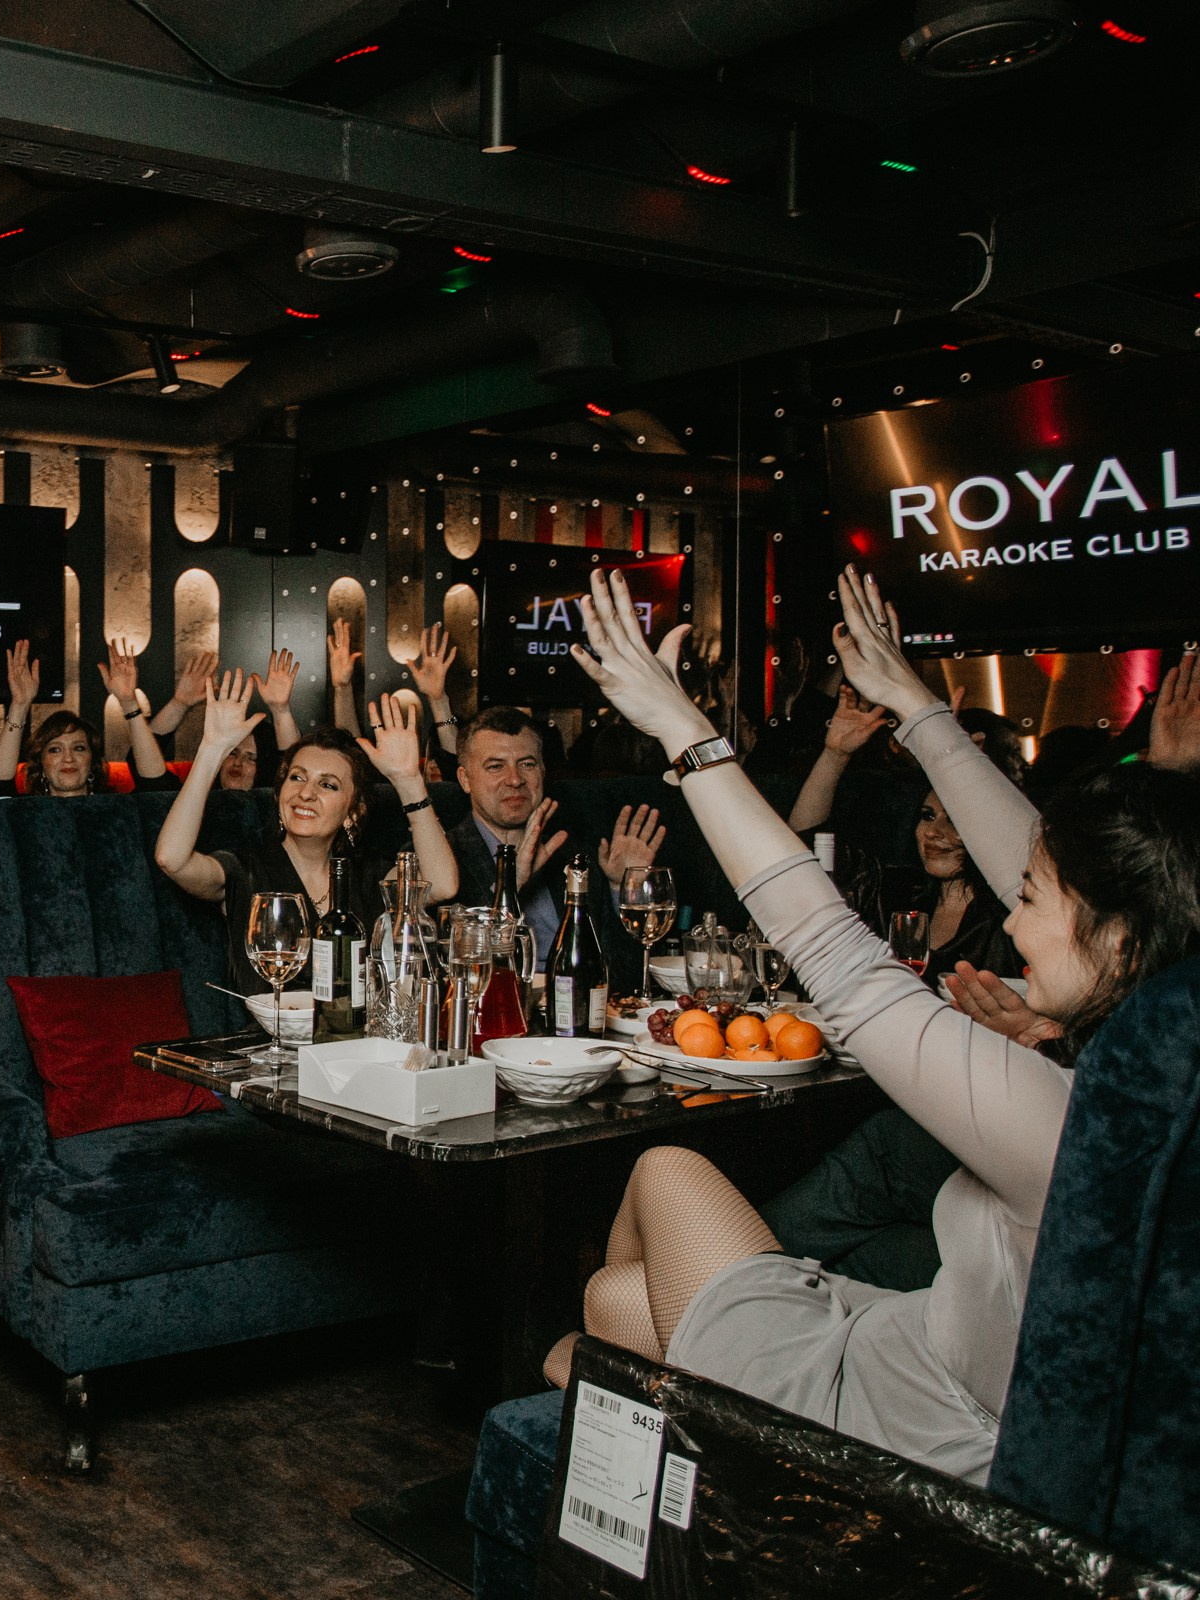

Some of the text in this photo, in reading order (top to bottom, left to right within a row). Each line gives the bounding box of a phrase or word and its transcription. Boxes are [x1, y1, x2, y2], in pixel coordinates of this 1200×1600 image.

[889, 449, 1200, 538] ROYAL
[920, 527, 1190, 572] KARAOKE CLUB
[632, 1411, 663, 1435] 9435
